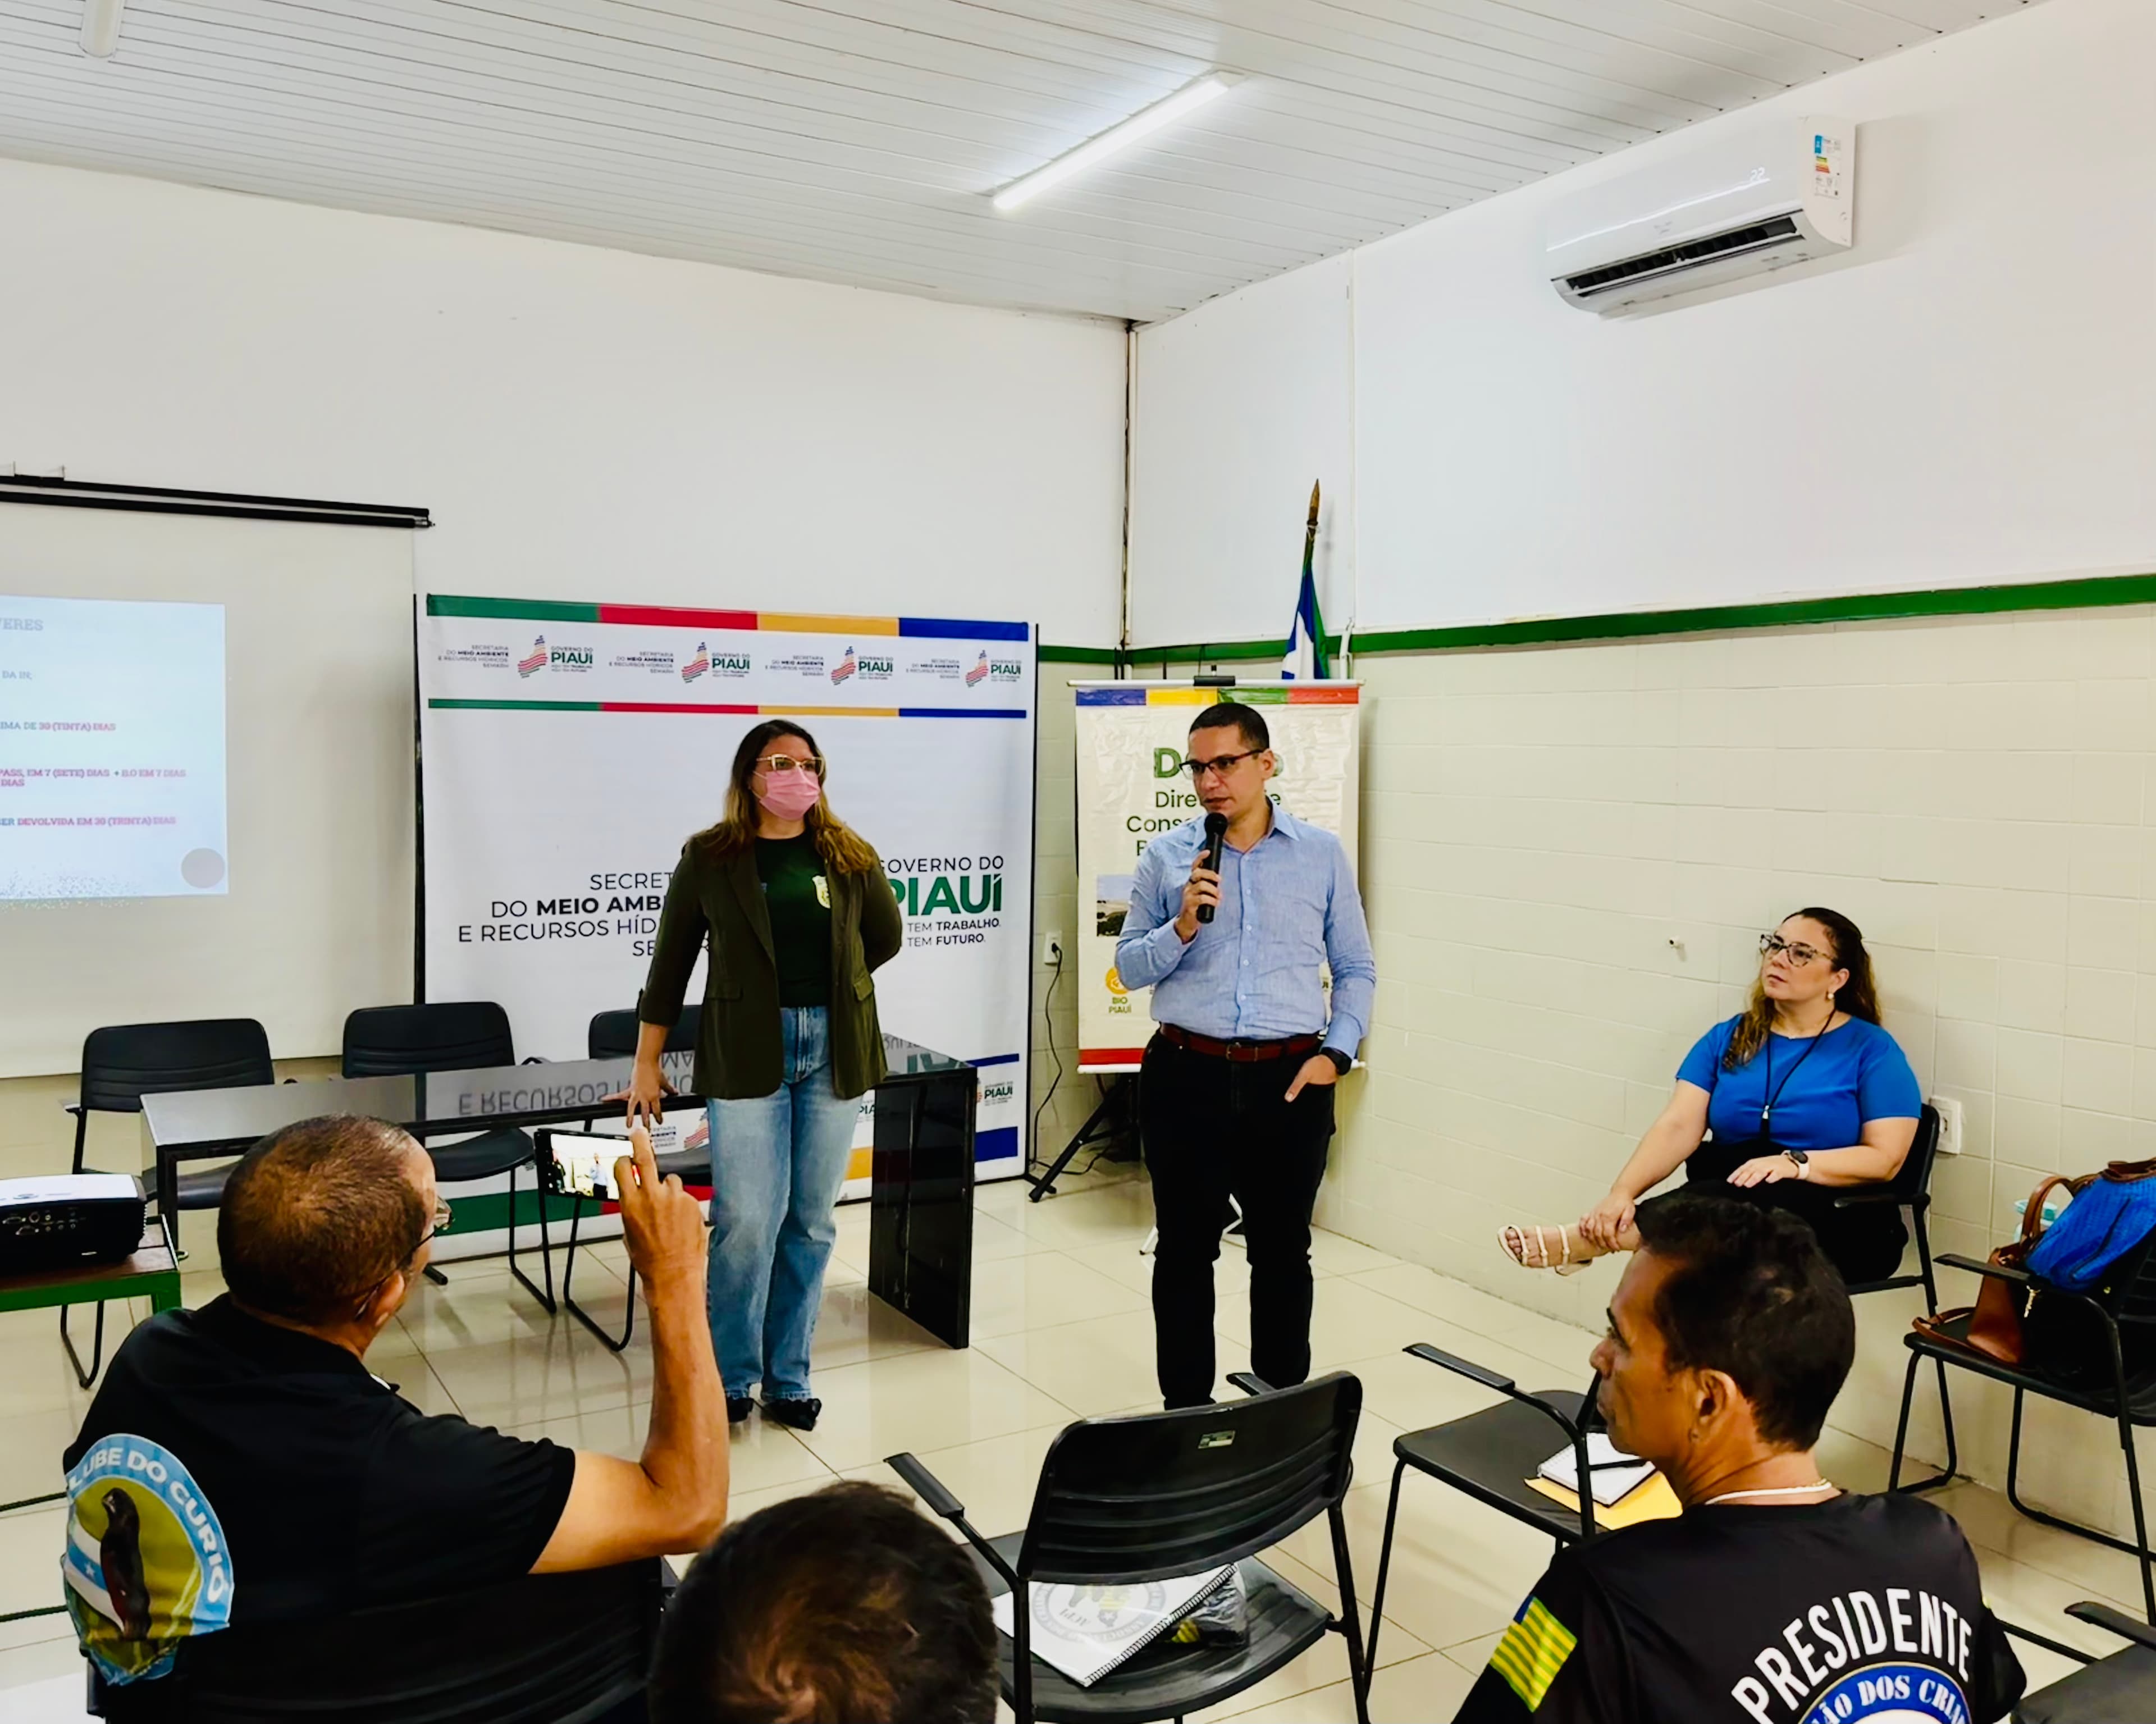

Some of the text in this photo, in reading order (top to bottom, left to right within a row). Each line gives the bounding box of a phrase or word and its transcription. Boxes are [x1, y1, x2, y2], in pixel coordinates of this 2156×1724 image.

[0, 618, 44, 631] ERES
[980, 856, 1004, 870] DO
[590, 872, 674, 890] SECRET
[492, 900, 527, 918] DO
[537, 898, 599, 916] MEIO
[459, 925, 472, 942] E
[482, 920, 609, 941] RECURSOS
[907, 918, 1001, 933] TEM TRABALHO.
[907, 933, 986, 948] TEM FUTURO.
[68, 1447, 230, 1603] LUBE DO CURIÓ
[1731, 1588, 1972, 1724] PRESIDENTE
[1857, 1675, 1910, 1706] DOS
